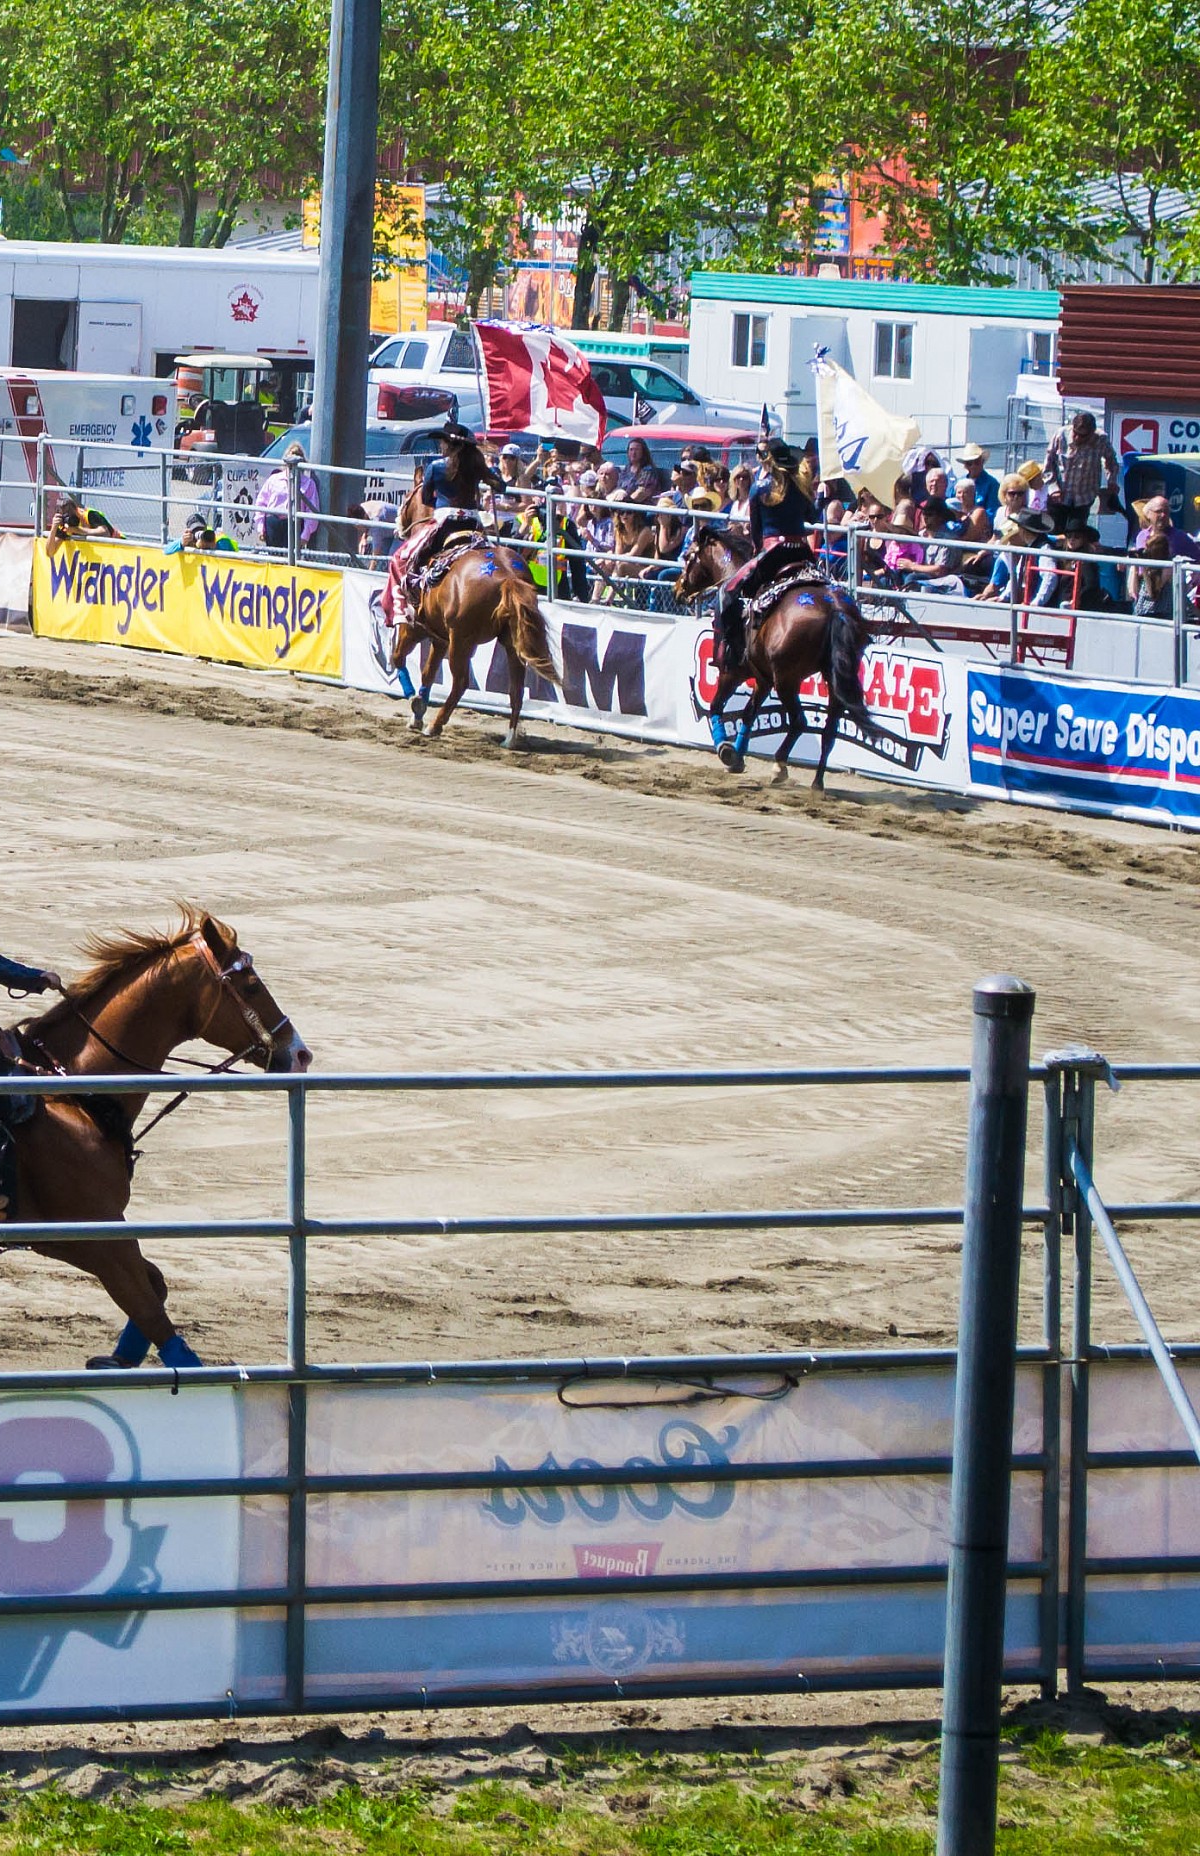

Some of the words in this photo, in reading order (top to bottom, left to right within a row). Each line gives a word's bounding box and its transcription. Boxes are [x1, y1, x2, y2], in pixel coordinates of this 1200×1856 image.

[69, 424, 117, 435] EMERGENCY
[68, 470, 125, 488] ABULANCE
[50, 550, 169, 635] Wrangler
[201, 564, 329, 658] Wrangler
[970, 690, 1049, 767] Super
[1055, 703, 1119, 755] Save
